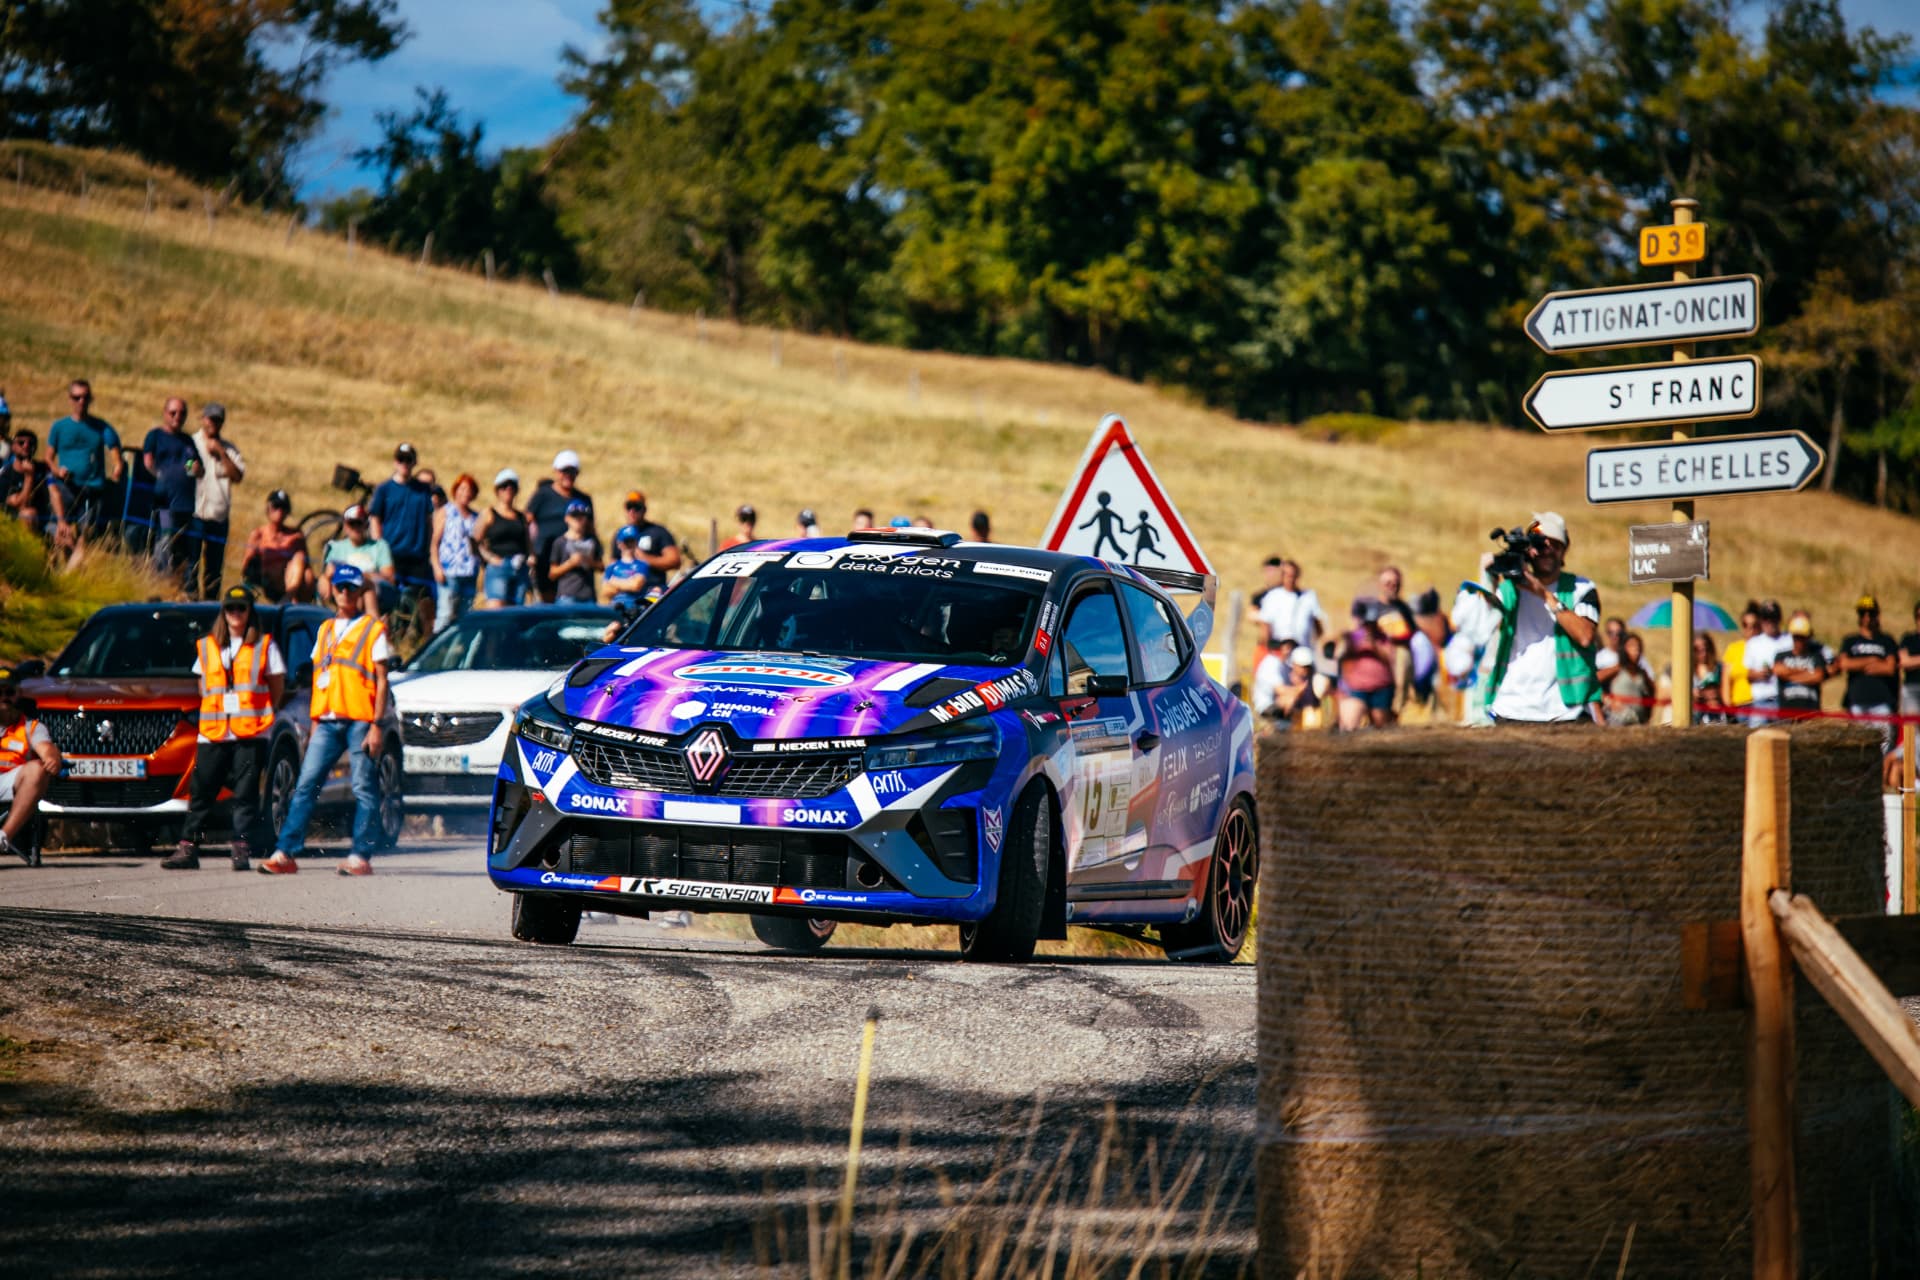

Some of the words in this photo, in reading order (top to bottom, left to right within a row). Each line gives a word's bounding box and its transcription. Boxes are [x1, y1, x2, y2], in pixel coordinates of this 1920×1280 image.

[1645, 233, 1660, 259] D
[1668, 229, 1701, 257] 39
[1551, 292, 1748, 337] ATTIGNAT-ONCIN
[1651, 374, 1744, 406] FRANC
[1597, 461, 1643, 489] LES
[1657, 450, 1792, 485] ÉCHELLES
[711, 562, 750, 575] 15
[839, 561, 886, 572] data
[890, 563, 954, 579] pilots
[849, 552, 961, 569] oxygen
[1634, 558, 1657, 575] LAC
[980, 675, 1028, 706] DUMAS
[593, 726, 637, 742] NEXEN
[637, 735, 668, 747] TIRE
[778, 740, 829, 751] NEXEN
[831, 738, 866, 749] TIRE
[90, 761, 114, 776] 371
[117, 761, 134, 776] SE
[571, 794, 628, 813] SONAX
[783, 808, 848, 825] SONAX
[667, 883, 770, 902] SUSPENSION
